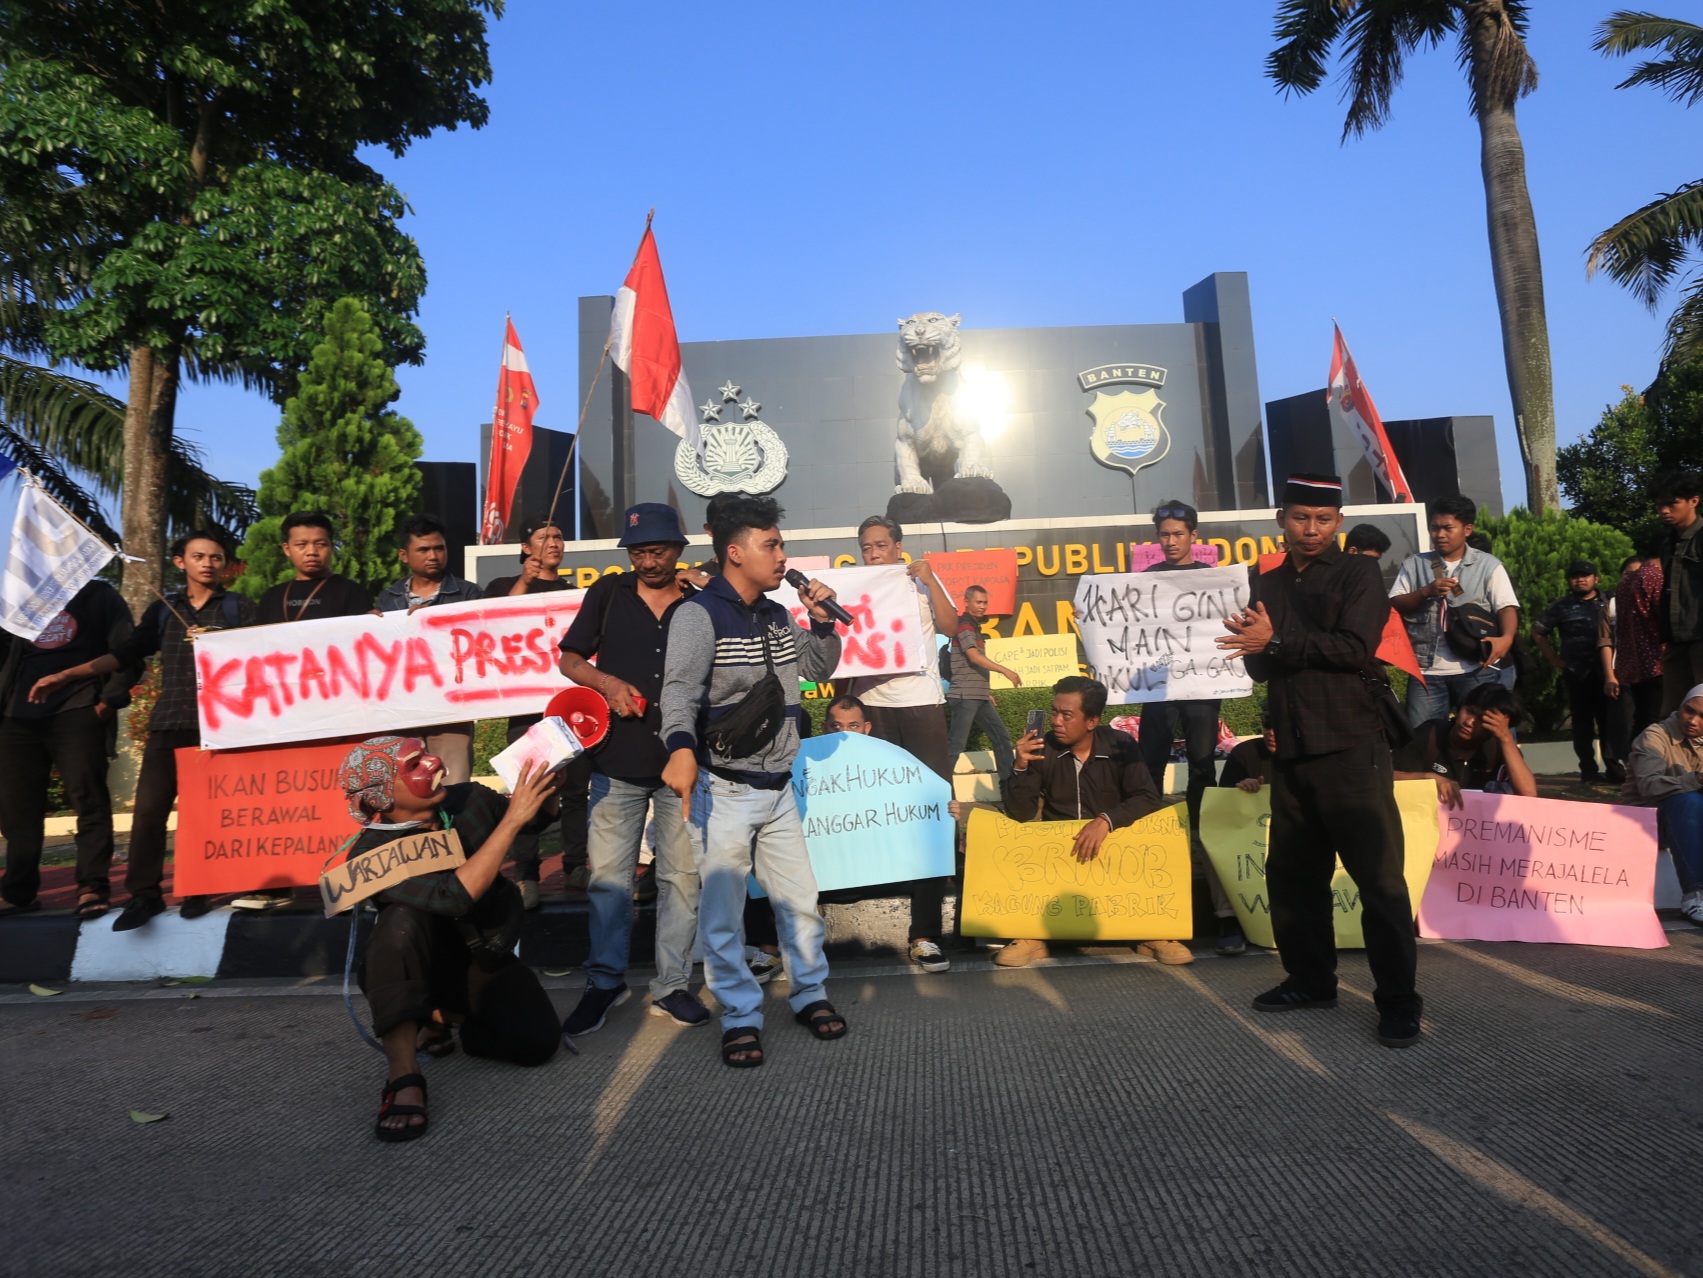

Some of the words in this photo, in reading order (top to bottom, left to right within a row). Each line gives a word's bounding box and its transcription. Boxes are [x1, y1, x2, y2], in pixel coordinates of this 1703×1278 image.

[1087, 368, 1160, 383] BANTEN
[1082, 584, 1159, 627] HARI
[1107, 625, 1191, 660] MAIN
[199, 630, 444, 730] KATANYA
[208, 772, 266, 799] IKAN
[846, 763, 923, 791] HUKUM
[220, 804, 322, 828] BERAWAL
[884, 801, 941, 826] HUKUM
[204, 838, 252, 860] DARI
[1447, 817, 1608, 852] PREMANISME
[324, 832, 454, 904] WARTAWAN
[1432, 851, 1493, 876] MASIH
[1499, 857, 1630, 888] MERAJALELA
[1074, 891, 1179, 920] PABRIK
[1457, 881, 1482, 905] DI
[1490, 885, 1584, 916] BANTEN
